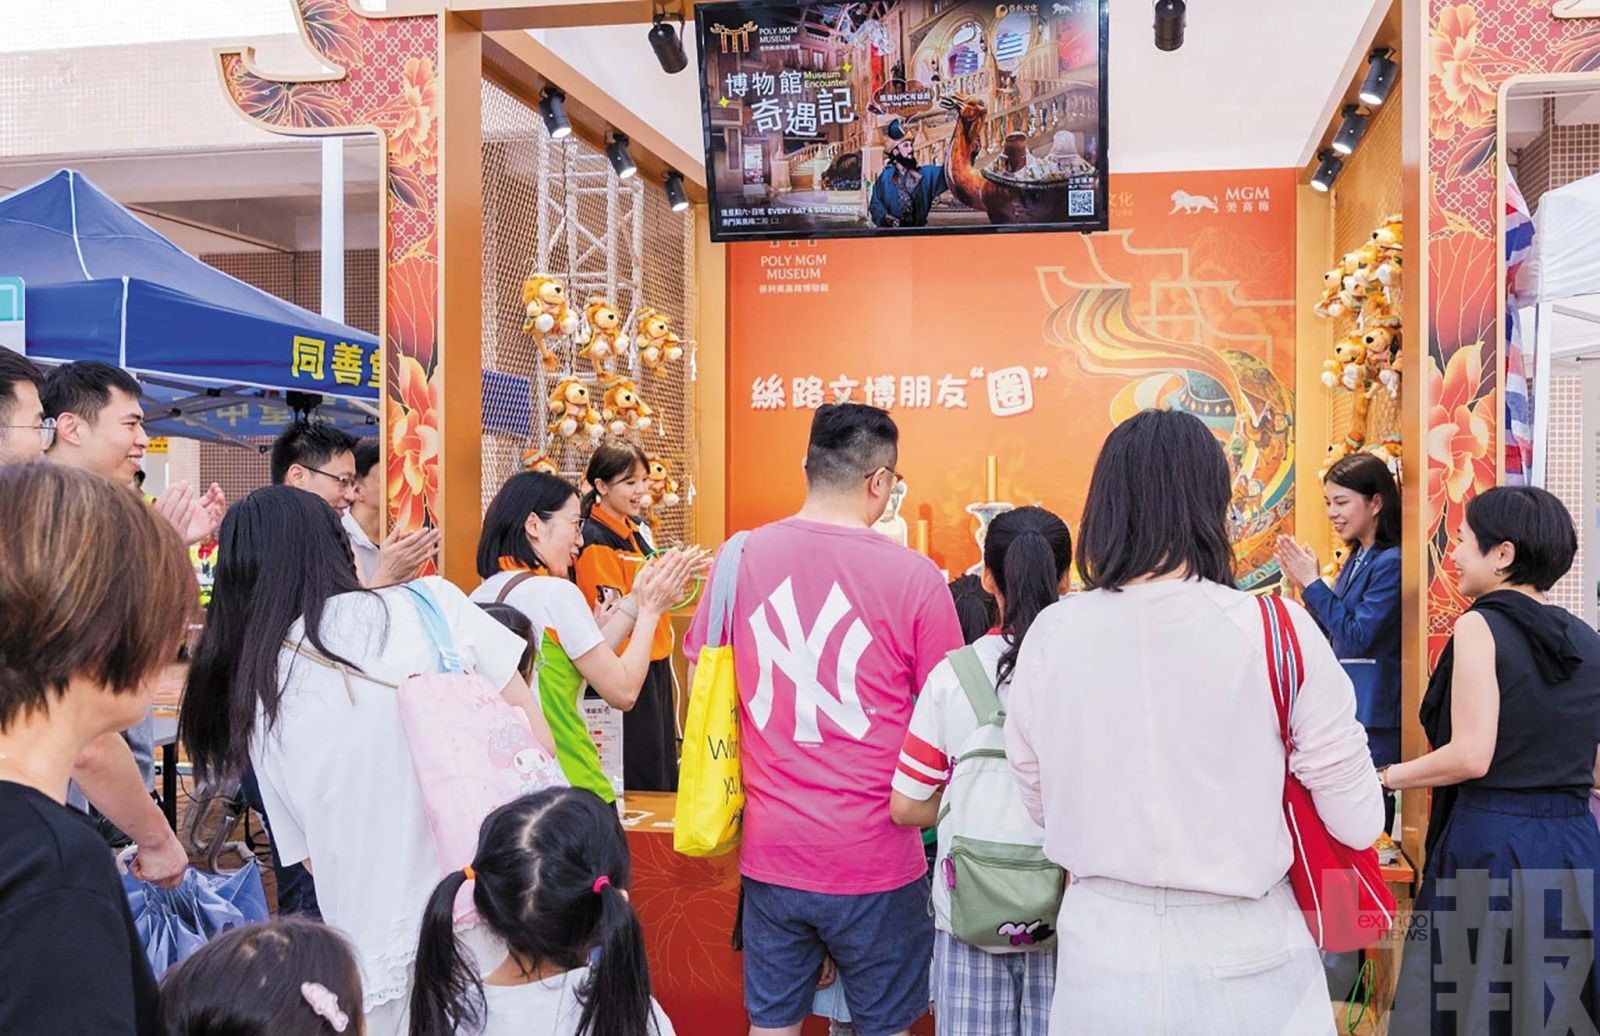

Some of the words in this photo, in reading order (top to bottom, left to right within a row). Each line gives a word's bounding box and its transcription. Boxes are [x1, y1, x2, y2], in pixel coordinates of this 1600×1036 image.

[779, 26, 798, 34] MGM
[760, 35, 792, 44] MUSEUM
[803, 71, 841, 79] Museum
[725, 70, 802, 98] 博物館
[804, 79, 849, 88] Encounter
[751, 87, 855, 136] 奇遇記
[1225, 186, 1270, 201] MGM
[1226, 202, 1270, 213] 美高梅
[760, 255, 792, 267] POLY
[795, 254, 827, 266] MGM
[766, 268, 821, 280] MUSEUM
[749, 575, 874, 743] NY
